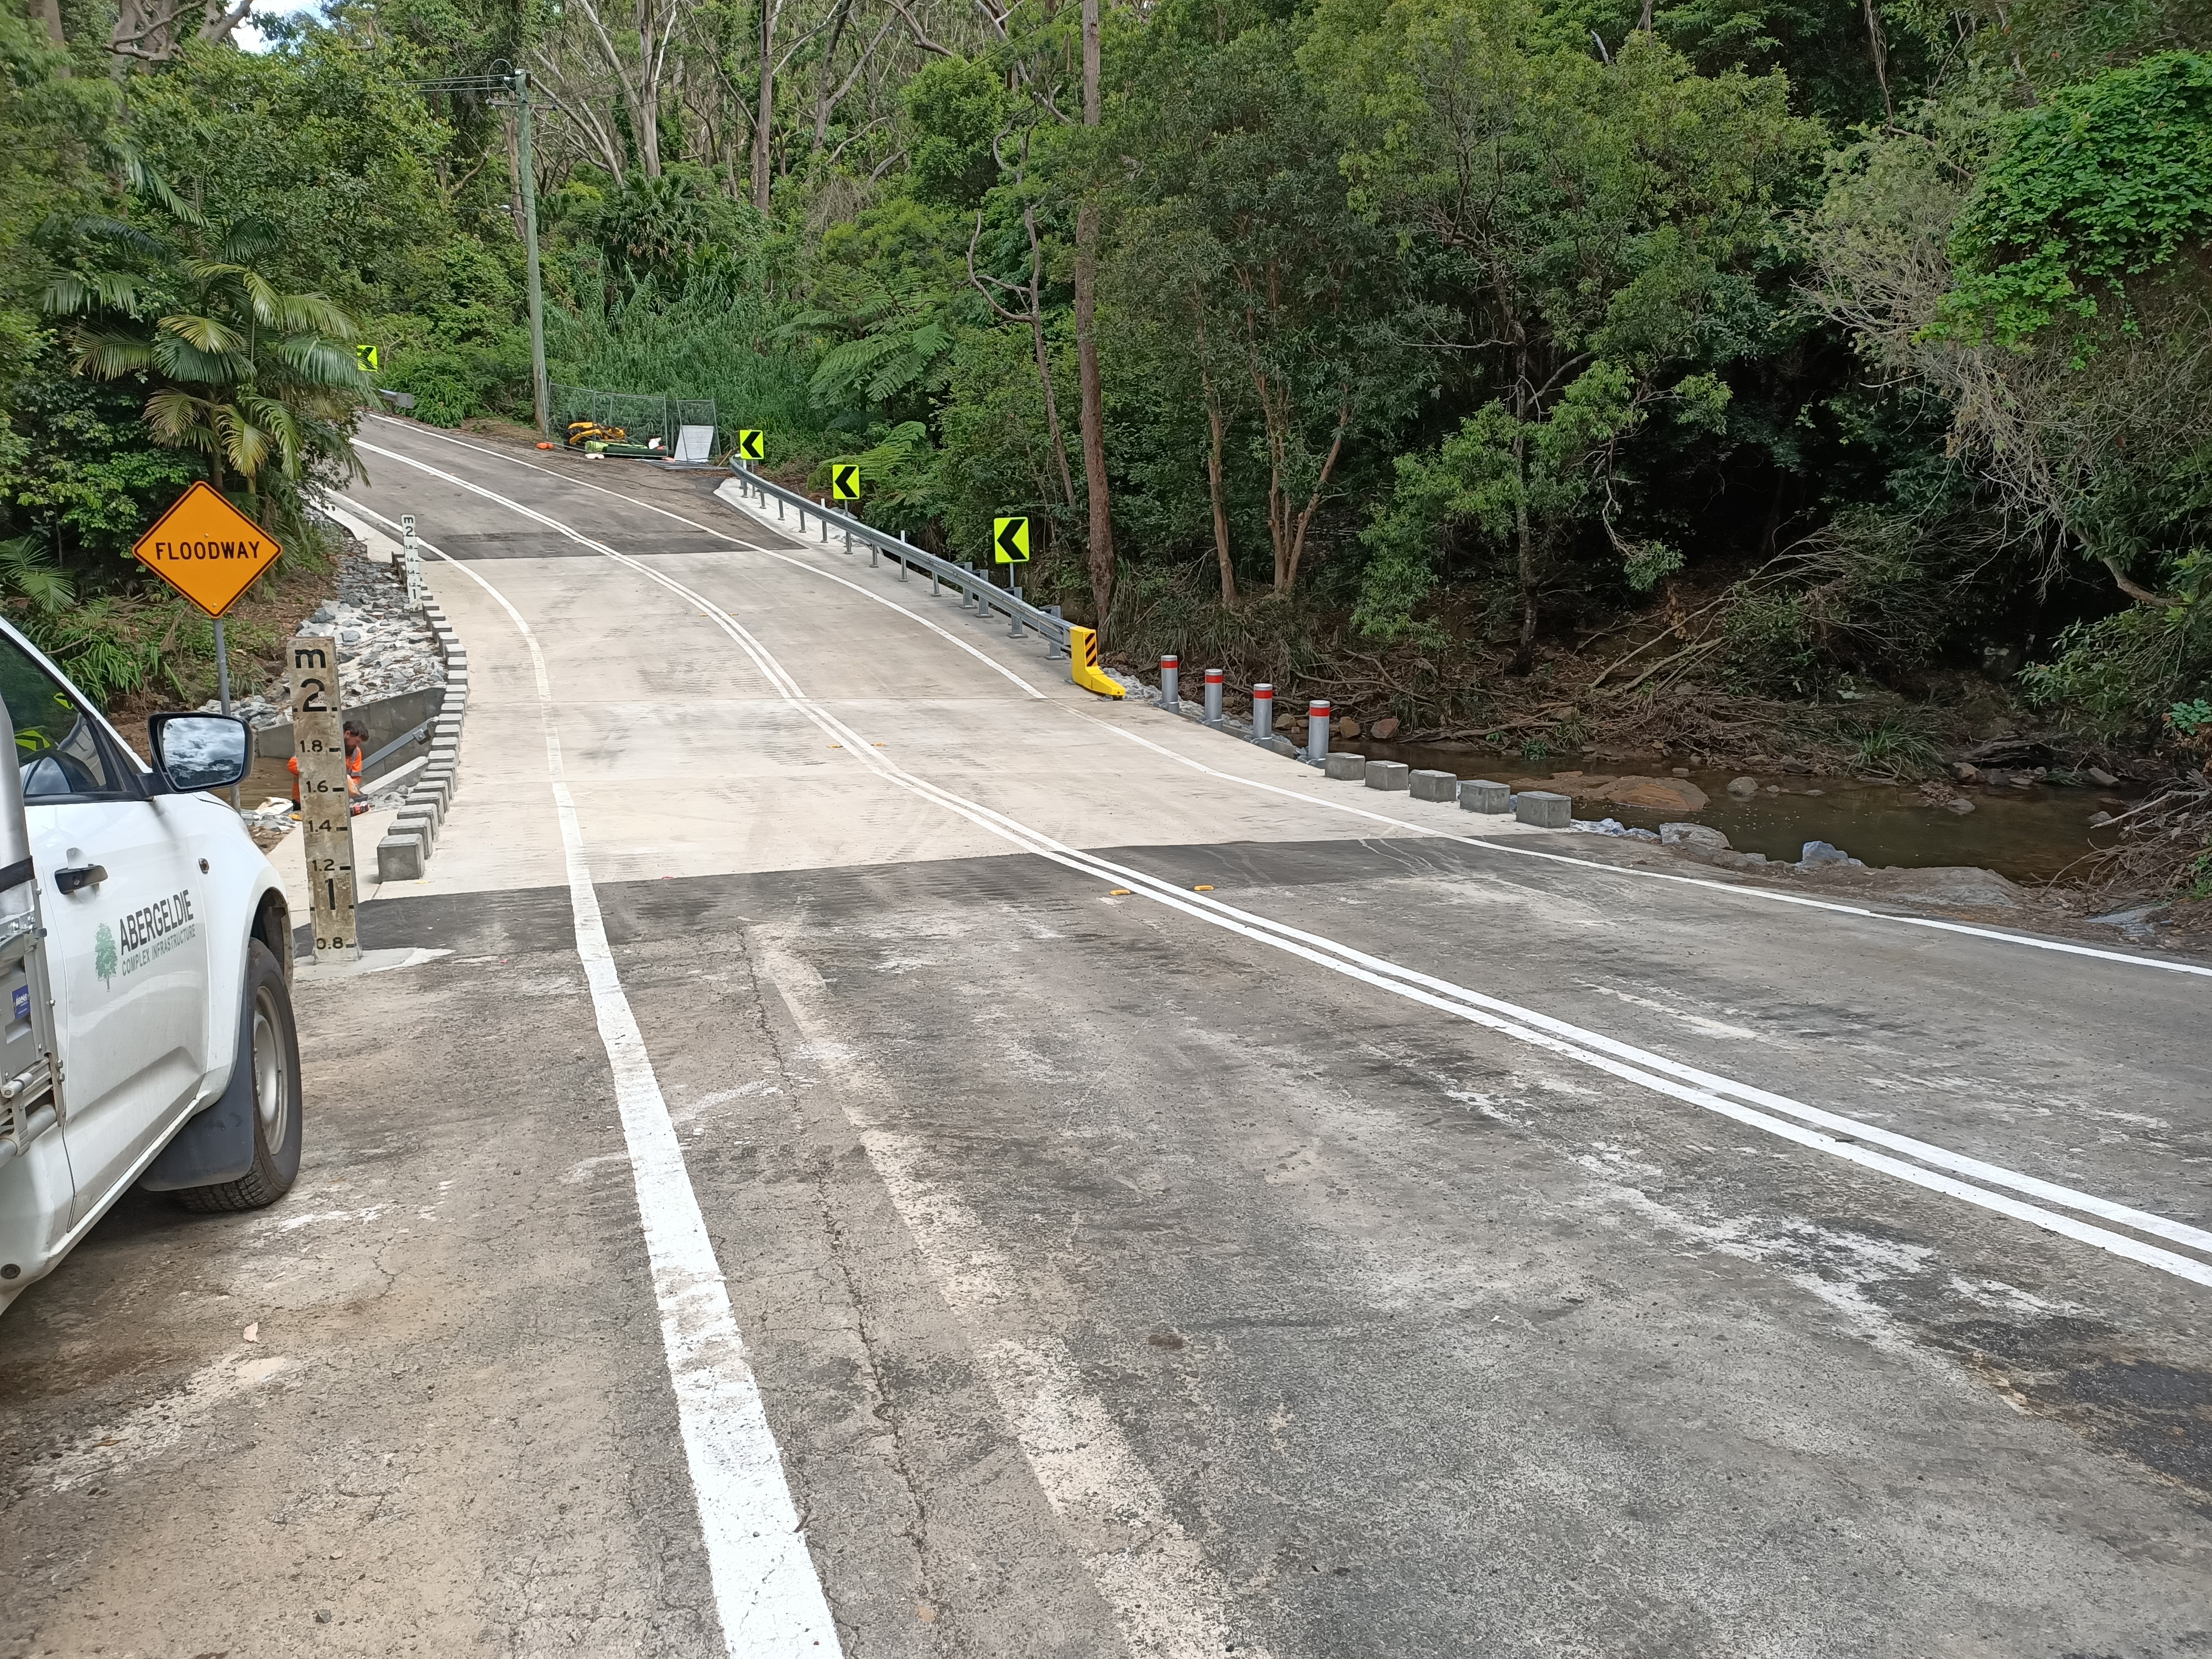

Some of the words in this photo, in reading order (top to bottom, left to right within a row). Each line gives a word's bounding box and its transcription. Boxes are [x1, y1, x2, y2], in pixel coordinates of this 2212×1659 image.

[405, 526, 414, 536] 2
[155, 541, 260, 560] FLOODWAY
[412, 589, 416, 599] 1
[295, 649, 326, 669] m
[300, 678, 327, 712] 2
[300, 739, 323, 753] 1.8
[306, 780, 328, 792] 1.6
[308, 820, 332, 832] 1.4
[312, 859, 335, 872] 1.2
[325, 878, 336, 910] 1
[119, 889, 194, 956] ABERGELDIE
[122, 945, 150, 976] COMPLEX
[152, 924, 196, 961] INFRASTRUCTURE
[316, 937, 344, 950] 0.8
